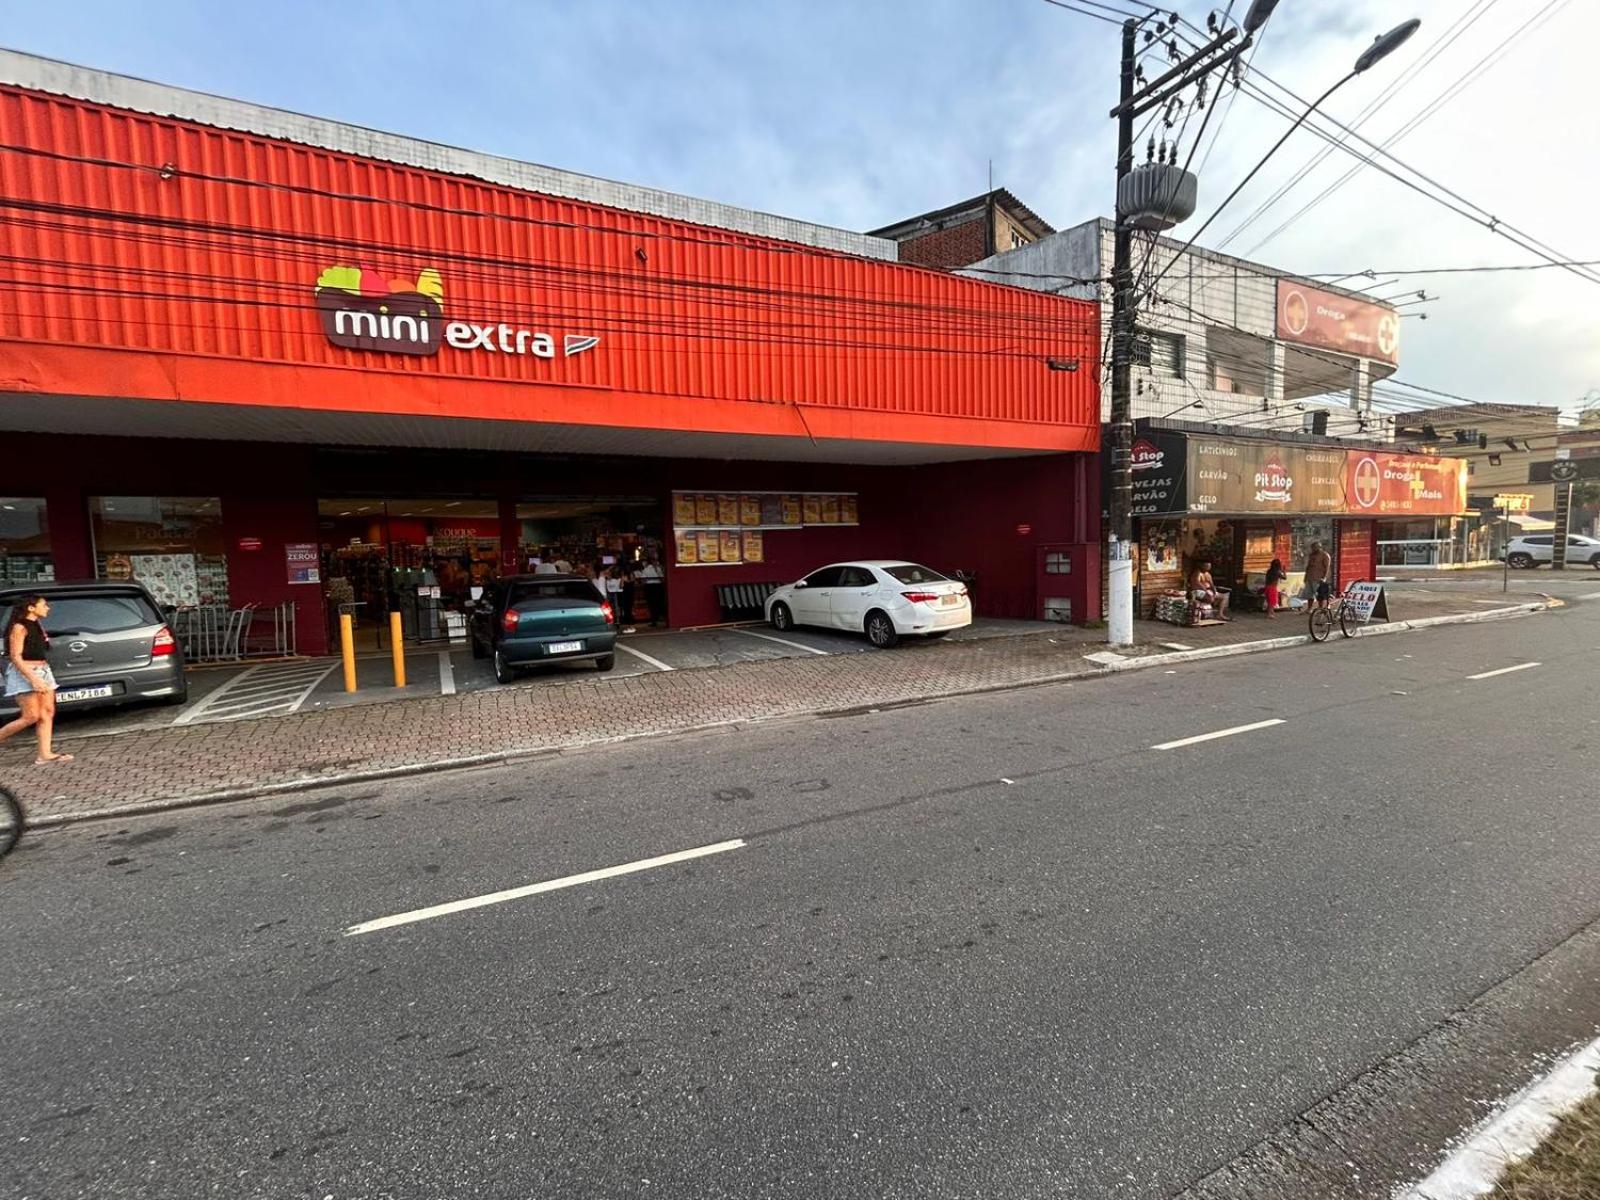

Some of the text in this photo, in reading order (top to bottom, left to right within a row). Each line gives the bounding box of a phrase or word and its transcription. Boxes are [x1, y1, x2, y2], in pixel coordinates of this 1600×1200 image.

[1316, 306, 1346, 321] Droga
[335, 305, 555, 358] mini extra
[1139, 451, 1165, 462] Stop
[1383, 469, 1415, 482] Droga
[1254, 473, 1293, 491] Pit Stop
[1417, 488, 1443, 499] Mais
[1199, 495, 1217, 504] GELO
[1132, 504, 1158, 514] ELO
[287, 553, 318, 561] ZEROU
